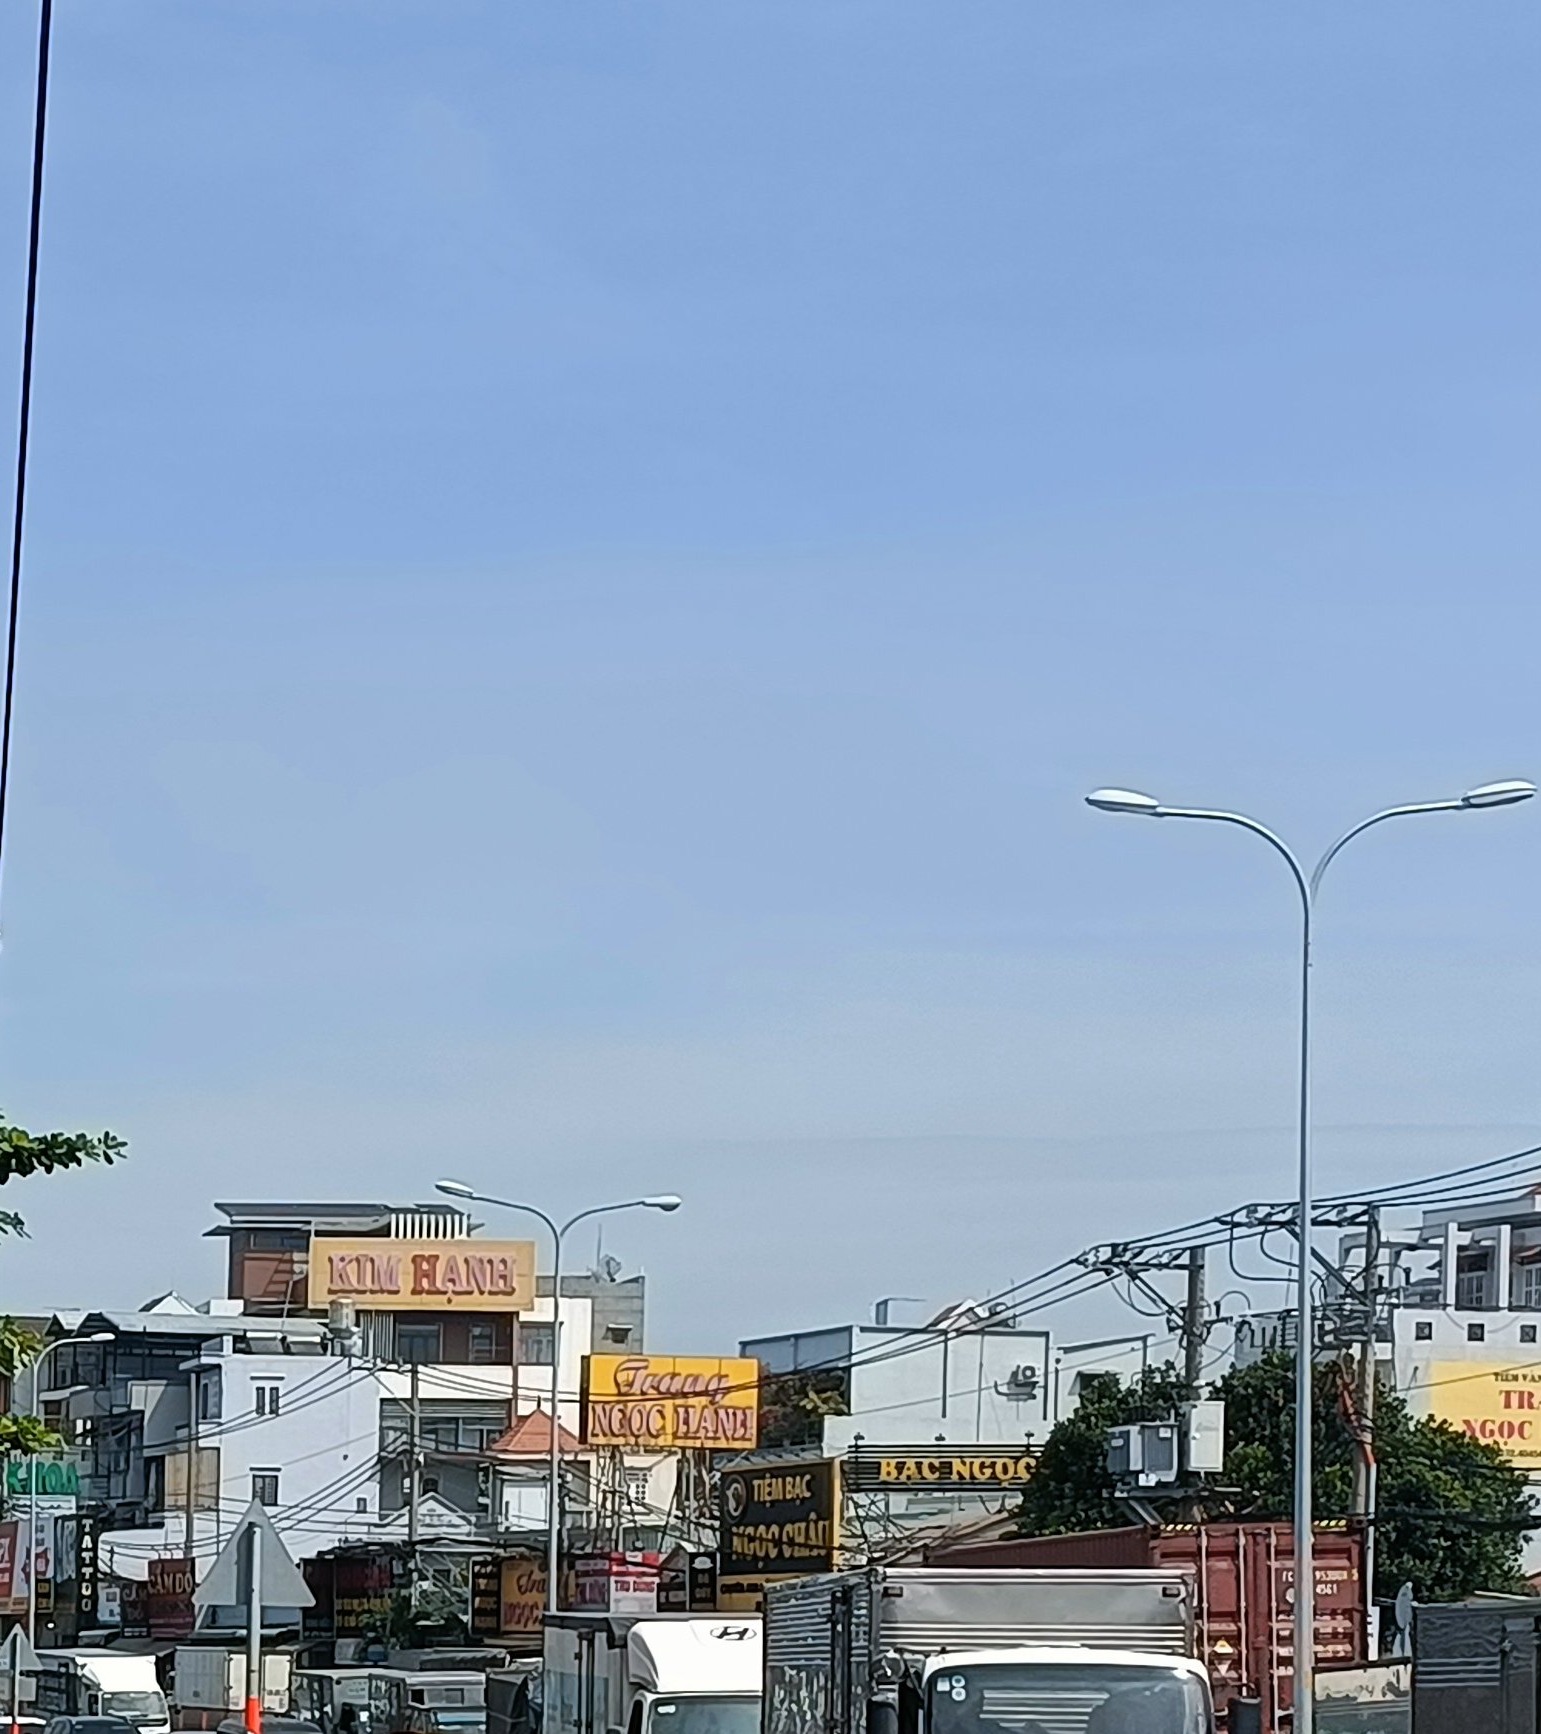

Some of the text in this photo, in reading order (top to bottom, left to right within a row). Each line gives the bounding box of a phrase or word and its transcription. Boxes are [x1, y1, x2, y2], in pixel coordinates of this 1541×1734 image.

[327, 1253, 517, 1304] KIM HẠNH
[1499, 1390, 1541, 1410] TR
[591, 1402, 667, 1443] NGỌC
[752, 1472, 812, 1508] TIỆM BẠC
[731, 1523, 780, 1569] NGỌC
